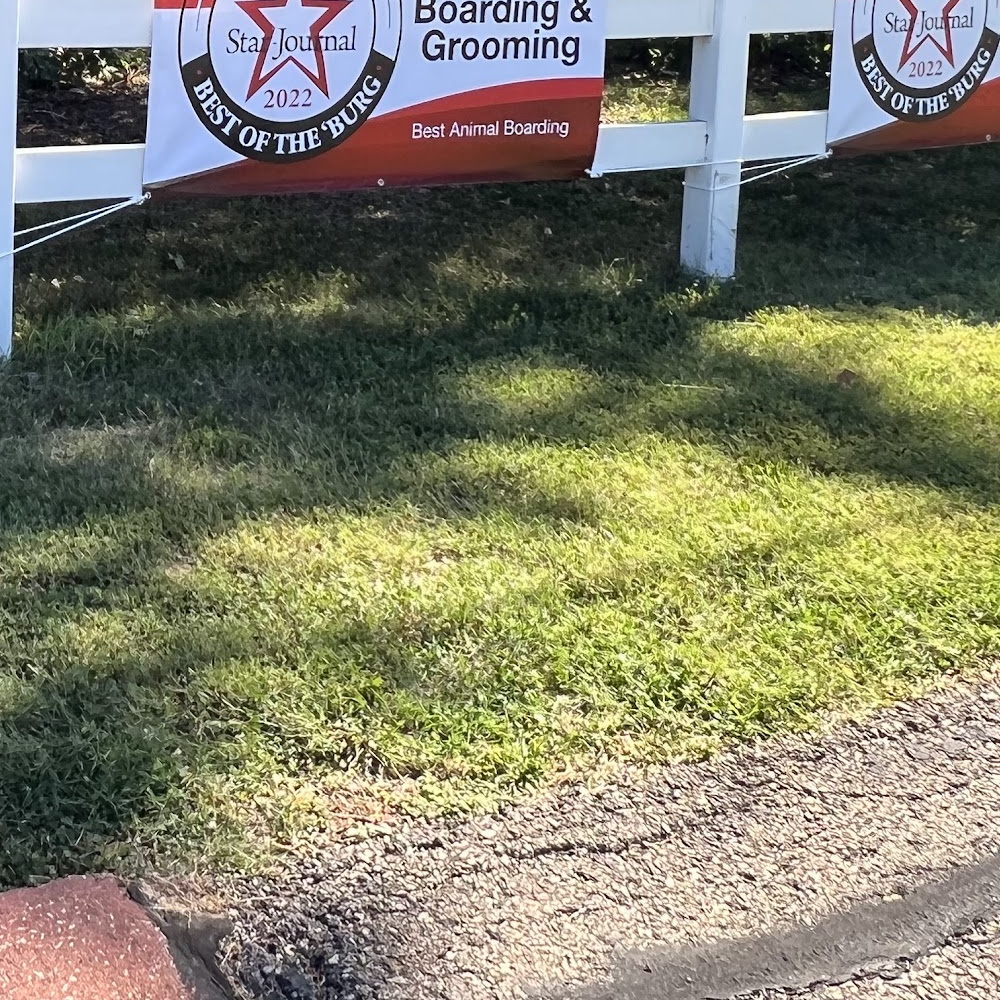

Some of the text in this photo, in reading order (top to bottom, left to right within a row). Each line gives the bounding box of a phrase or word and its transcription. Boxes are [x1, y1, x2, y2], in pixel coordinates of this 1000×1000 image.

[421, 29, 580, 66] Grooming
[908, 60, 943, 77] 2022
[263, 88, 313, 109] 2022
[860, 52, 893, 101] BEST
[890, 91, 913, 114] OF
[912, 93, 950, 116] THE
[193, 76, 242, 135] BEST
[238, 125, 271, 153] OF
[272, 127, 322, 155] THE
[411, 119, 569, 139] Best Animal Boarding
